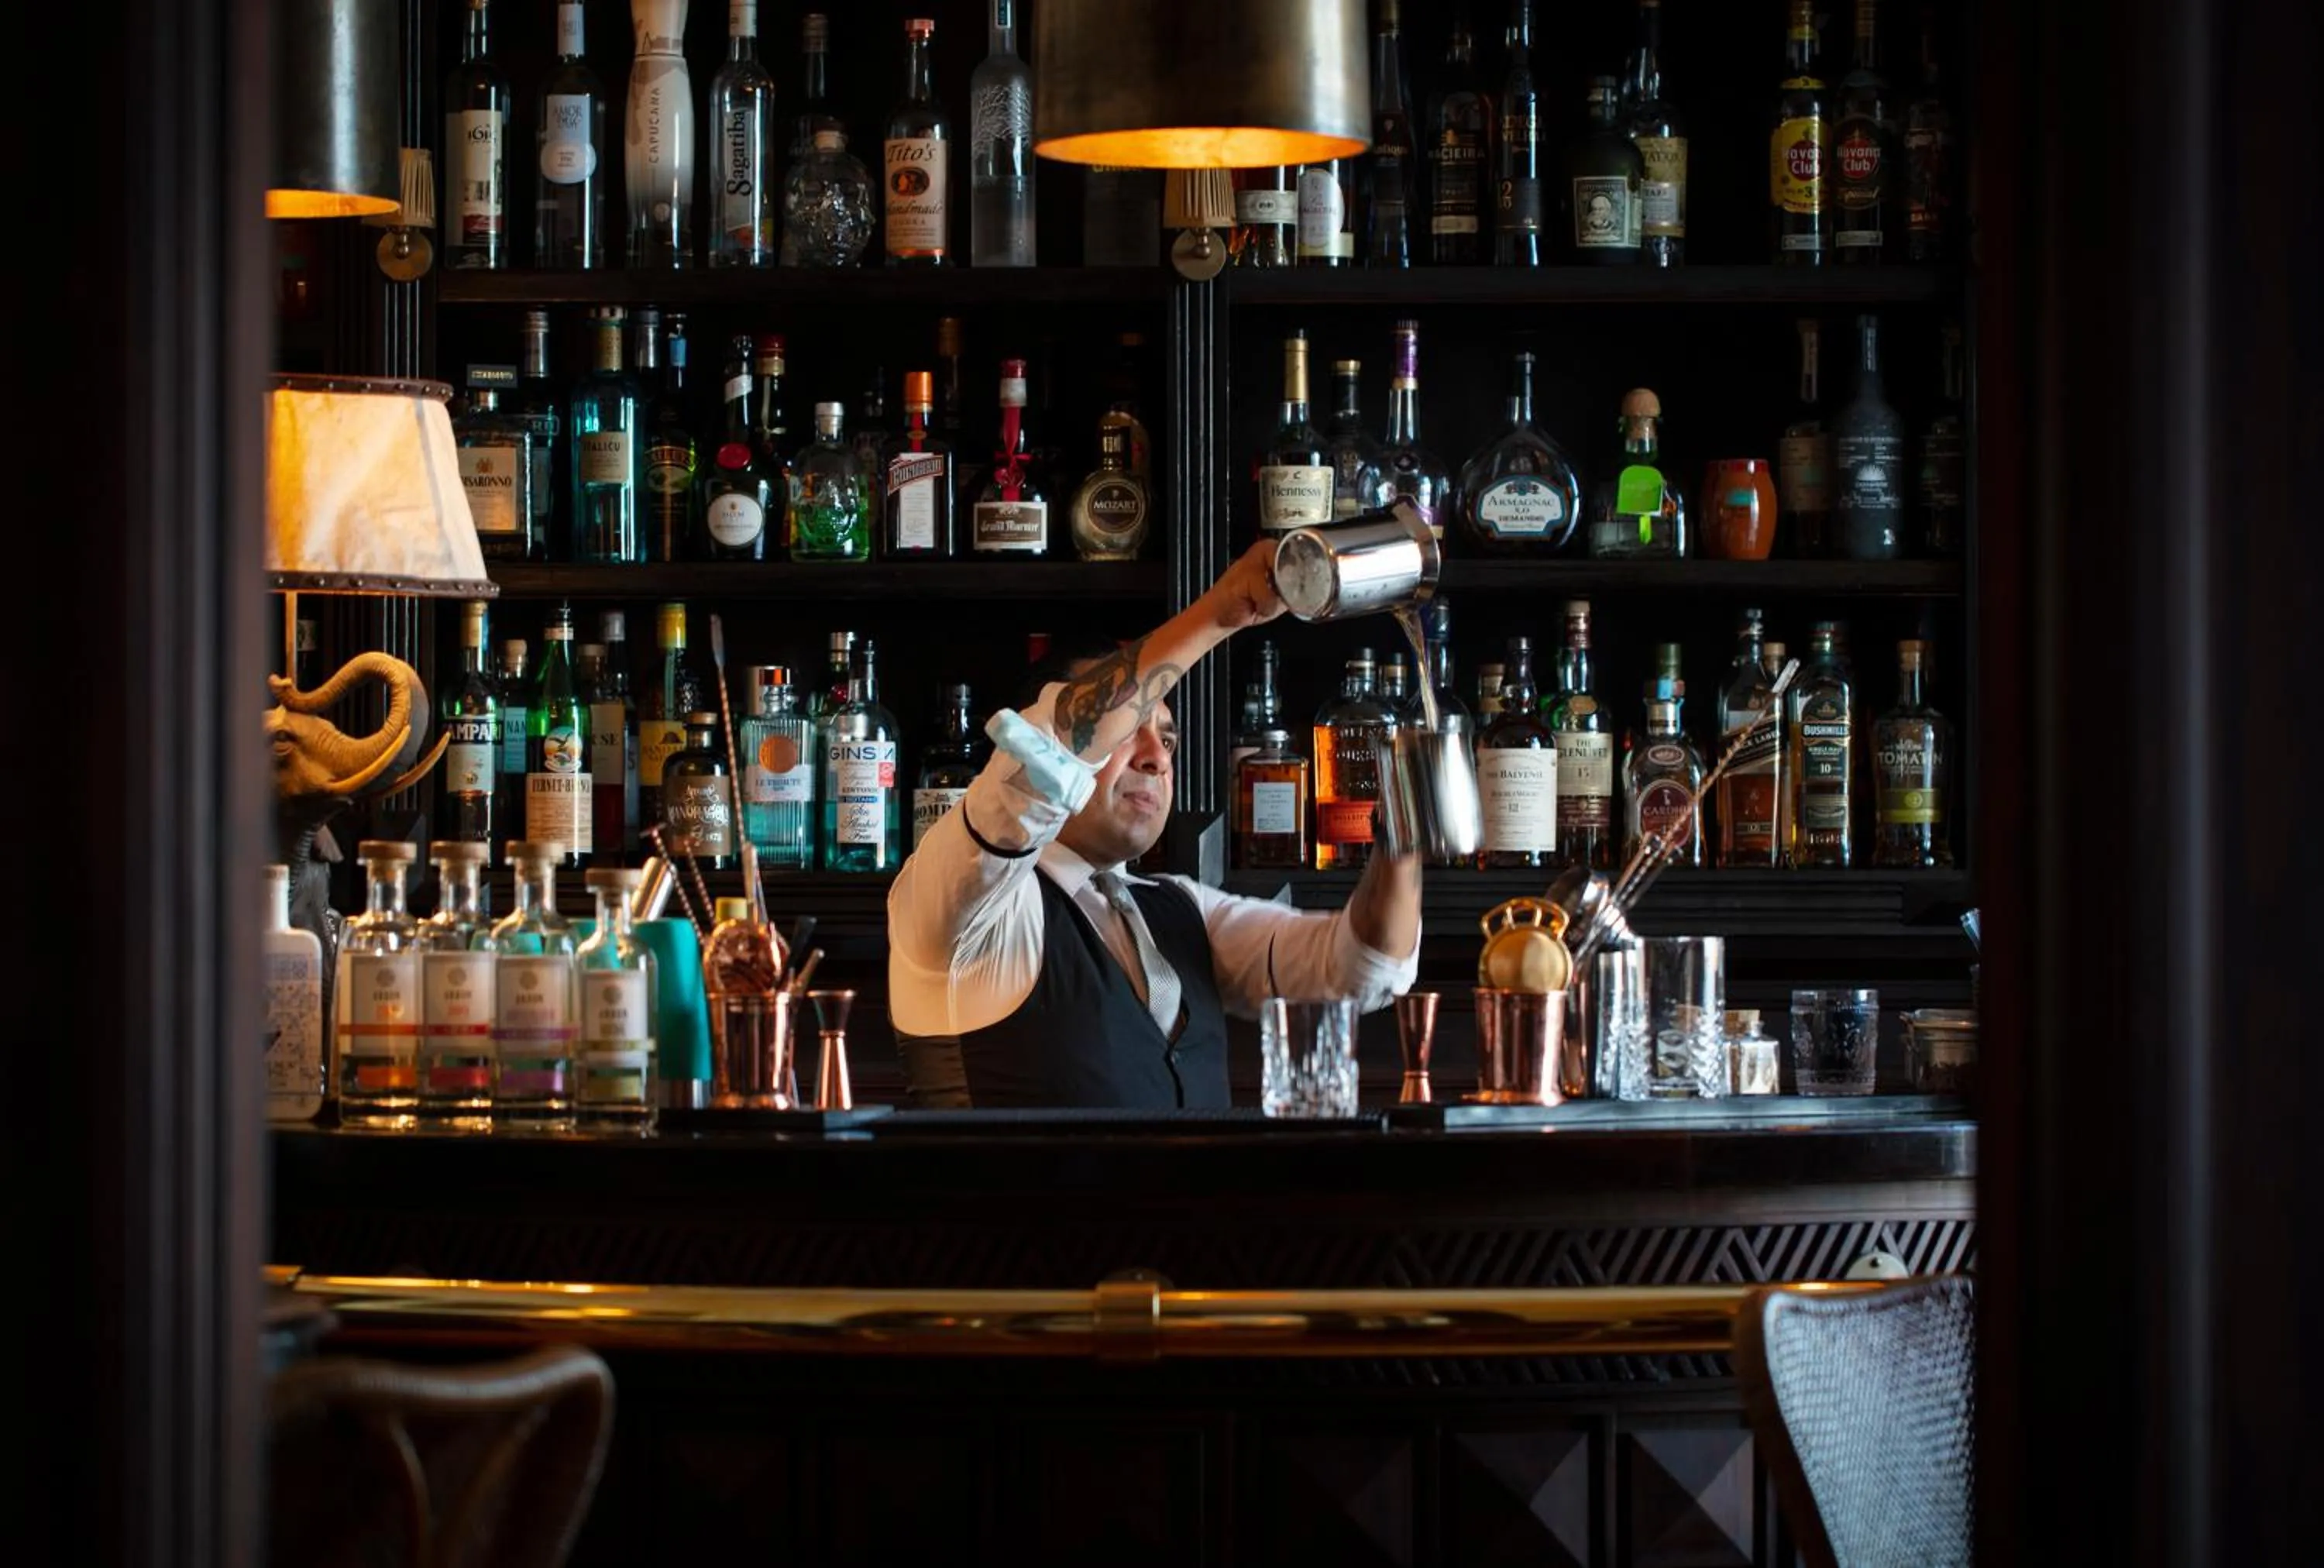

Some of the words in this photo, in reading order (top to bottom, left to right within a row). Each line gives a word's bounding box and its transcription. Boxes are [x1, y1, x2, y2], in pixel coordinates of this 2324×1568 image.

[648, 86, 662, 163] CAPUCANA
[726, 110, 754, 198] Sagatiba
[886, 142, 936, 165] Tito's
[1844, 159, 1871, 171] Club
[1093, 500, 1136, 510] MOZART
[1487, 496, 1555, 507] ARMAGNAC
[448, 722, 503, 741] AMPARI
[1803, 725, 1850, 737] BUSHMILLS
[1877, 751, 1944, 766] TOMATN
[1820, 762, 1832, 774] 10
